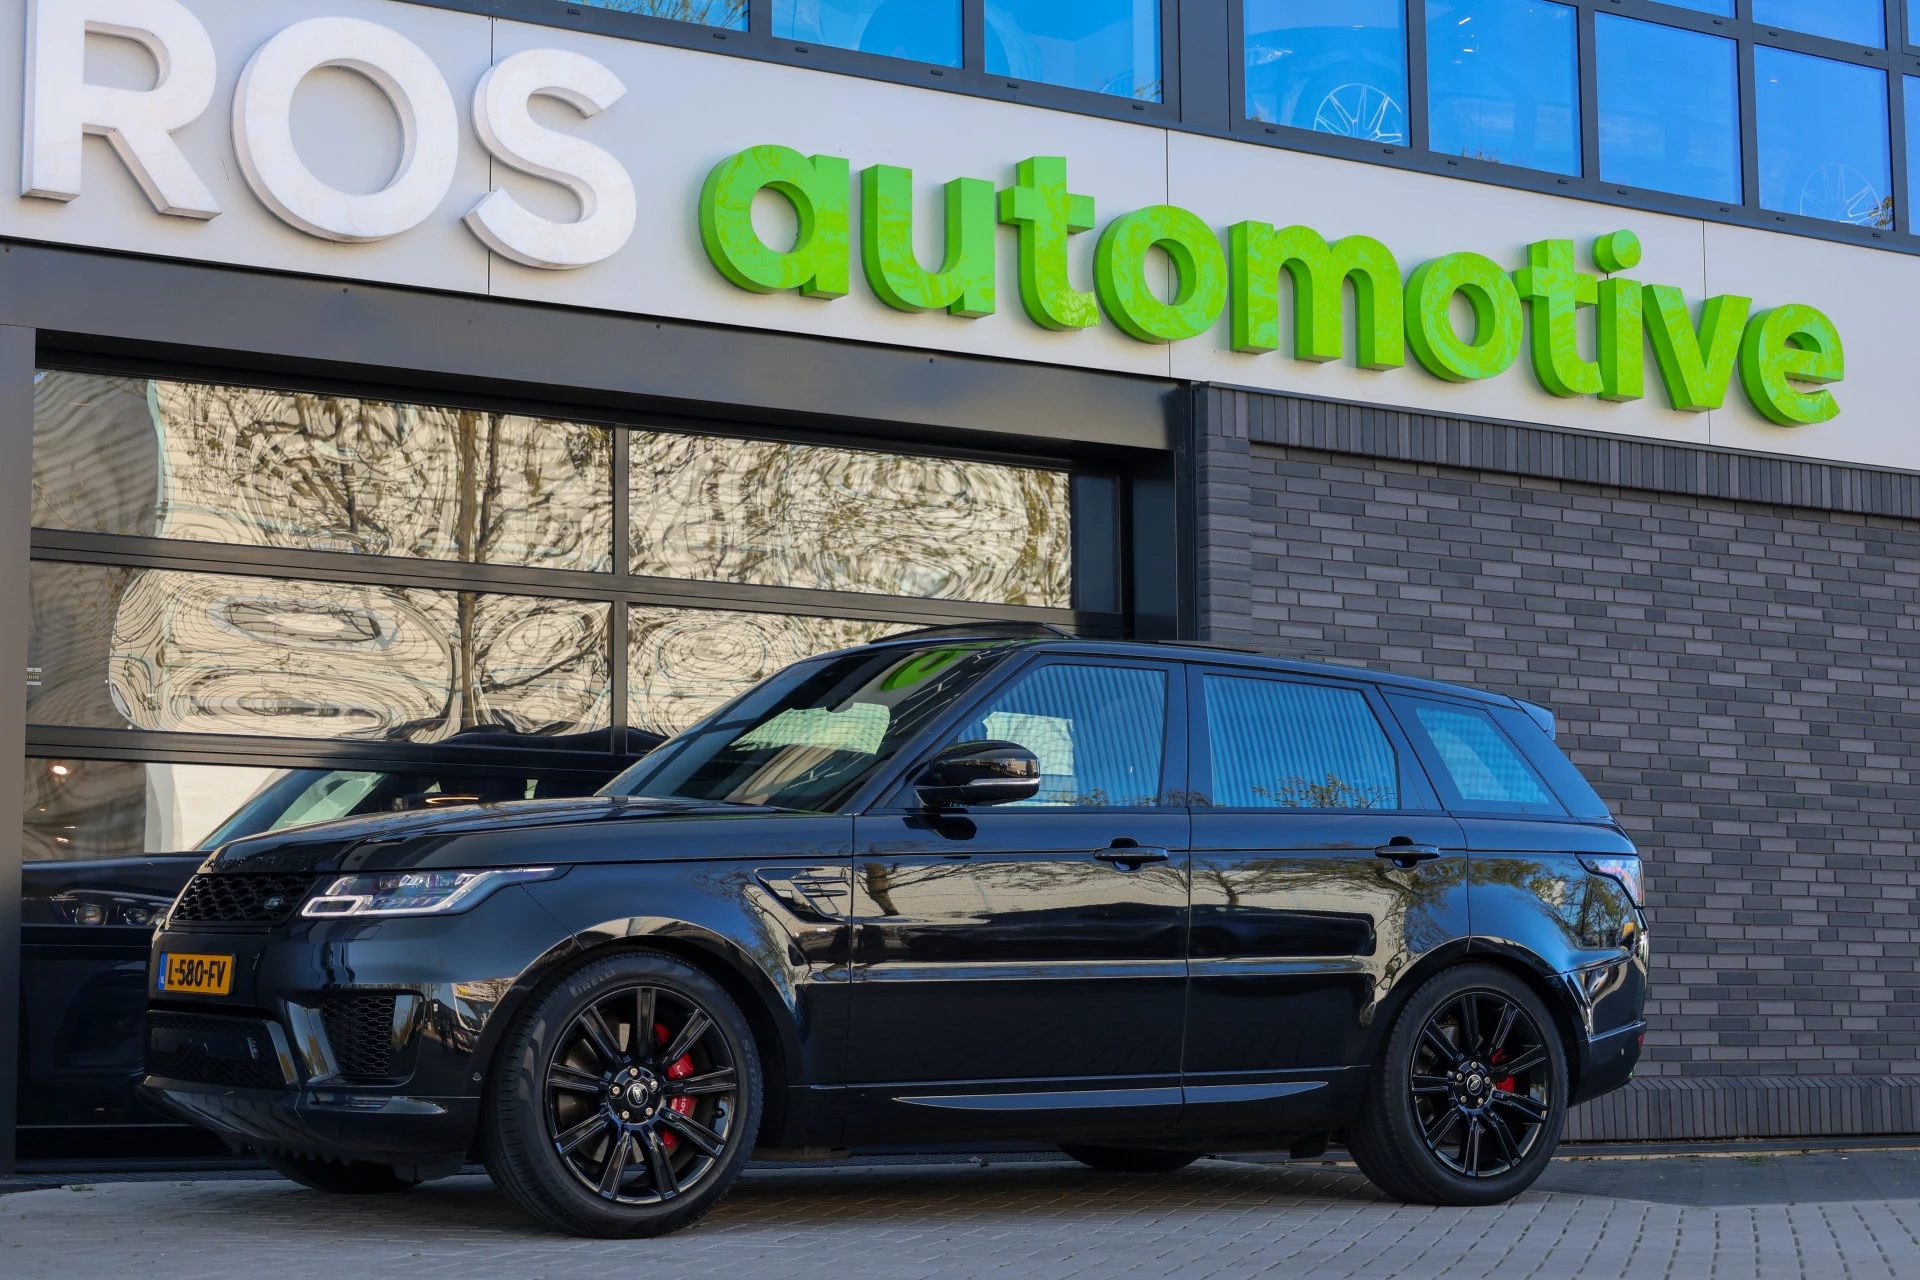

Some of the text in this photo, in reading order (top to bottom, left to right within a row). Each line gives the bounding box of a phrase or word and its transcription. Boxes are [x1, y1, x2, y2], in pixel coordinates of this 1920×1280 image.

[20, 0, 1845, 428] ROS automotive
[167, 958, 226, 988] L-580-FV
[569, 968, 616, 999] PIRELLI
